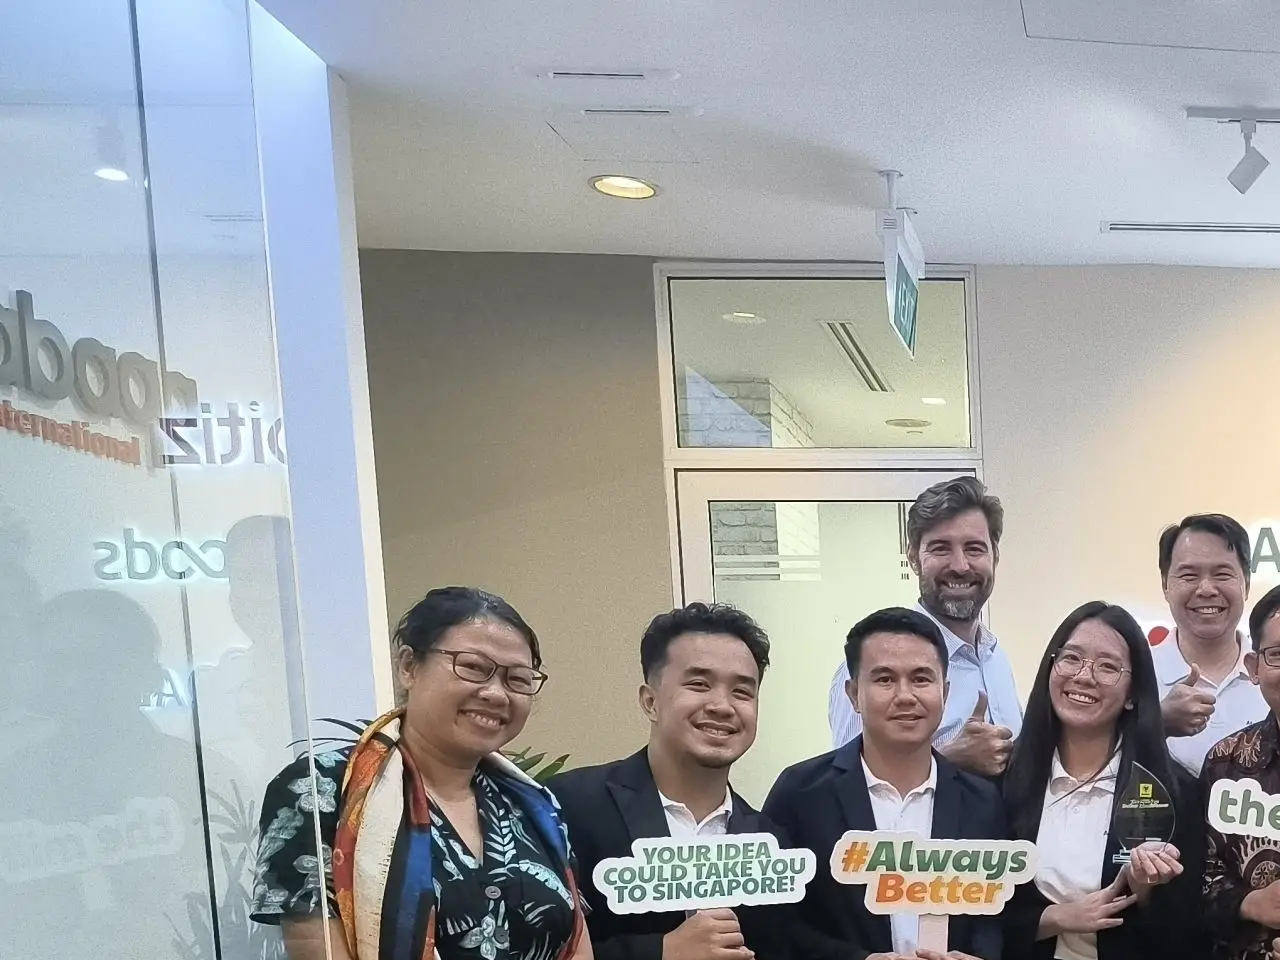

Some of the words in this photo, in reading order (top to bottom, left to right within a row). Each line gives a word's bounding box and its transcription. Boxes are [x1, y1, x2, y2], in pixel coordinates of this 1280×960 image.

[0, 399, 141, 465] ternational
[643, 845, 711, 865] YOUR
[716, 842, 771, 861] IDEA
[841, 840, 1028, 880] #Always
[603, 864, 688, 886] COULD
[693, 861, 753, 880] TAKE
[758, 857, 806, 876] YOU
[614, 885, 647, 903] TO
[652, 875, 795, 901] SINGAPORE!
[875, 874, 1004, 904] Better
